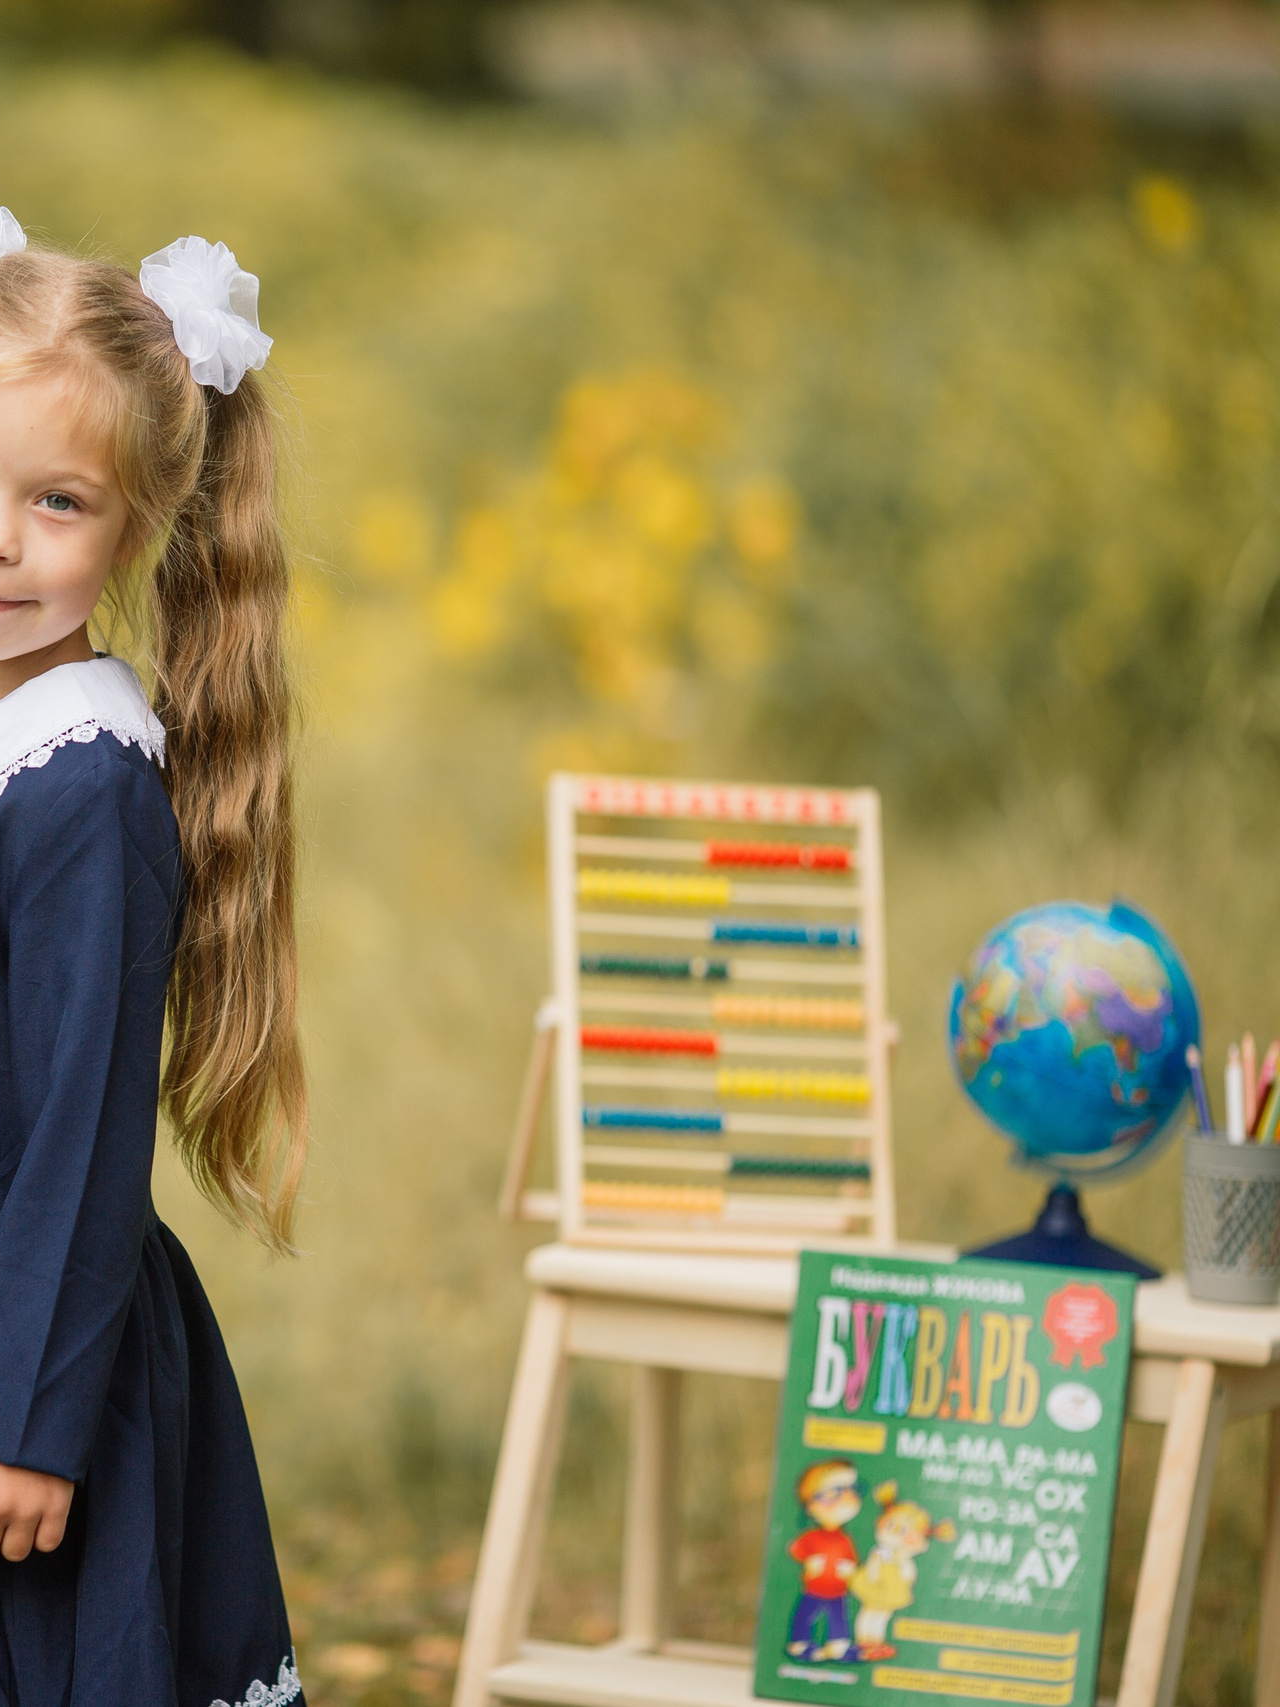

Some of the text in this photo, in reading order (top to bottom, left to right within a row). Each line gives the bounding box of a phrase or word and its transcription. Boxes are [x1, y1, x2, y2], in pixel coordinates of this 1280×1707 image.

[807, 1296, 1041, 1428] БУКВАРЬ
[1034, 1478, 1088, 1514] ОХ
[954, 1529, 1014, 1565] АМ
[1013, 1546, 1081, 1589] АУ
